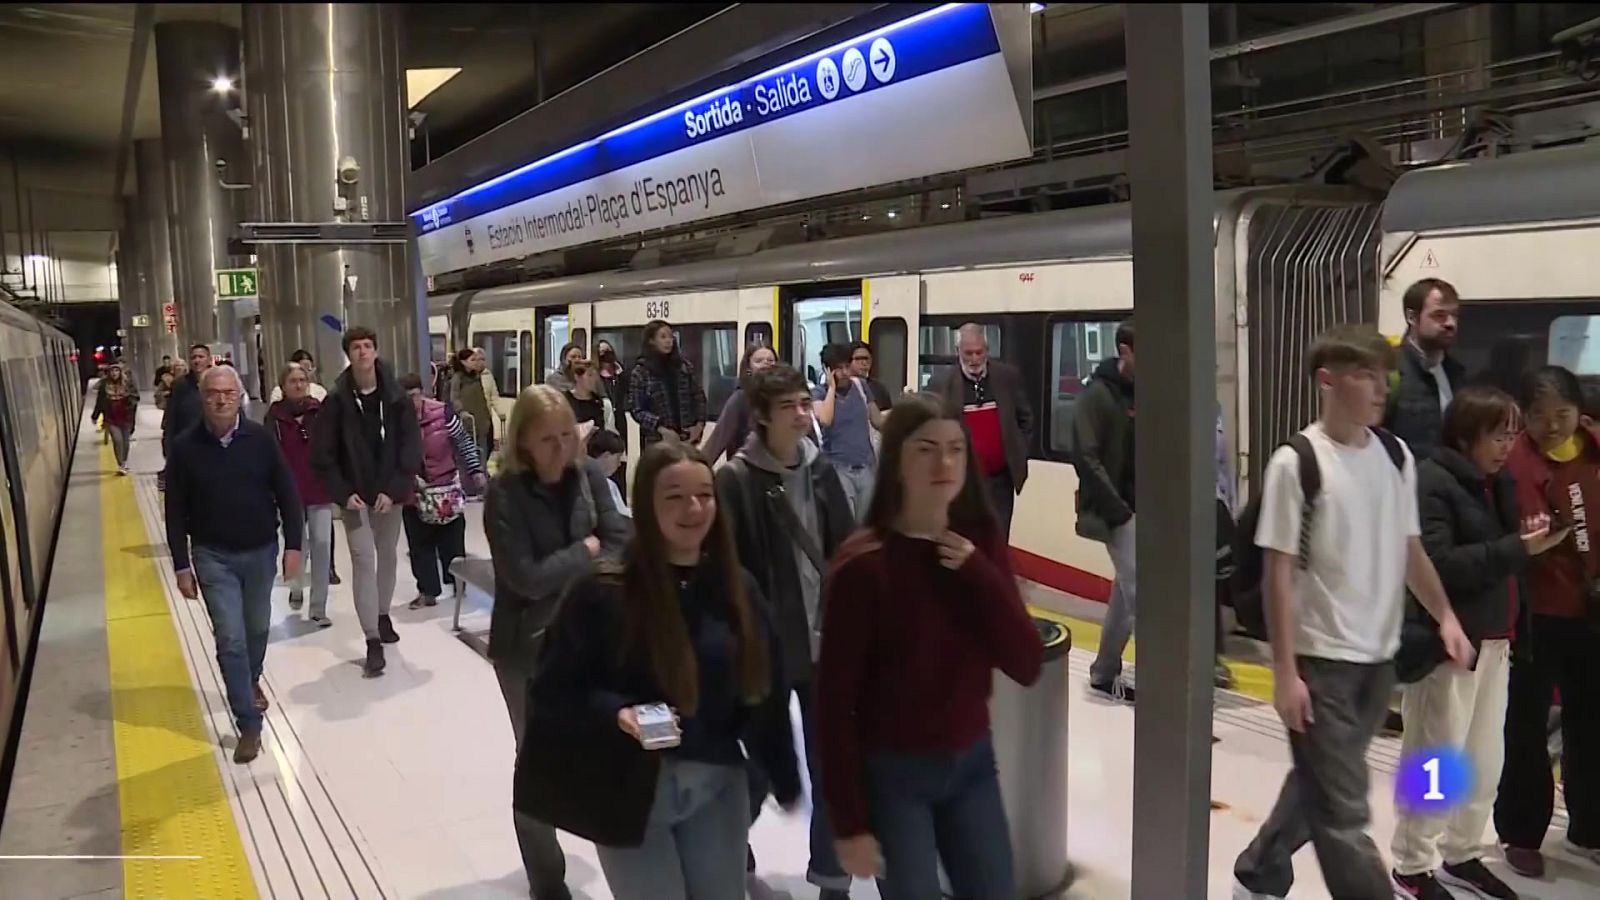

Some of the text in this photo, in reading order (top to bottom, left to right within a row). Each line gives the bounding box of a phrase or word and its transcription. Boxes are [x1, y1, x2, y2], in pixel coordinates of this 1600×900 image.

[684, 97, 743, 138] Sortida
[755, 72, 812, 116] Salida
[488, 218, 522, 249] Estació
[524, 194, 629, 240] Intermodal-Plaça
[631, 167, 725, 216] d'Espanya
[646, 300, 670, 318] 83-18
